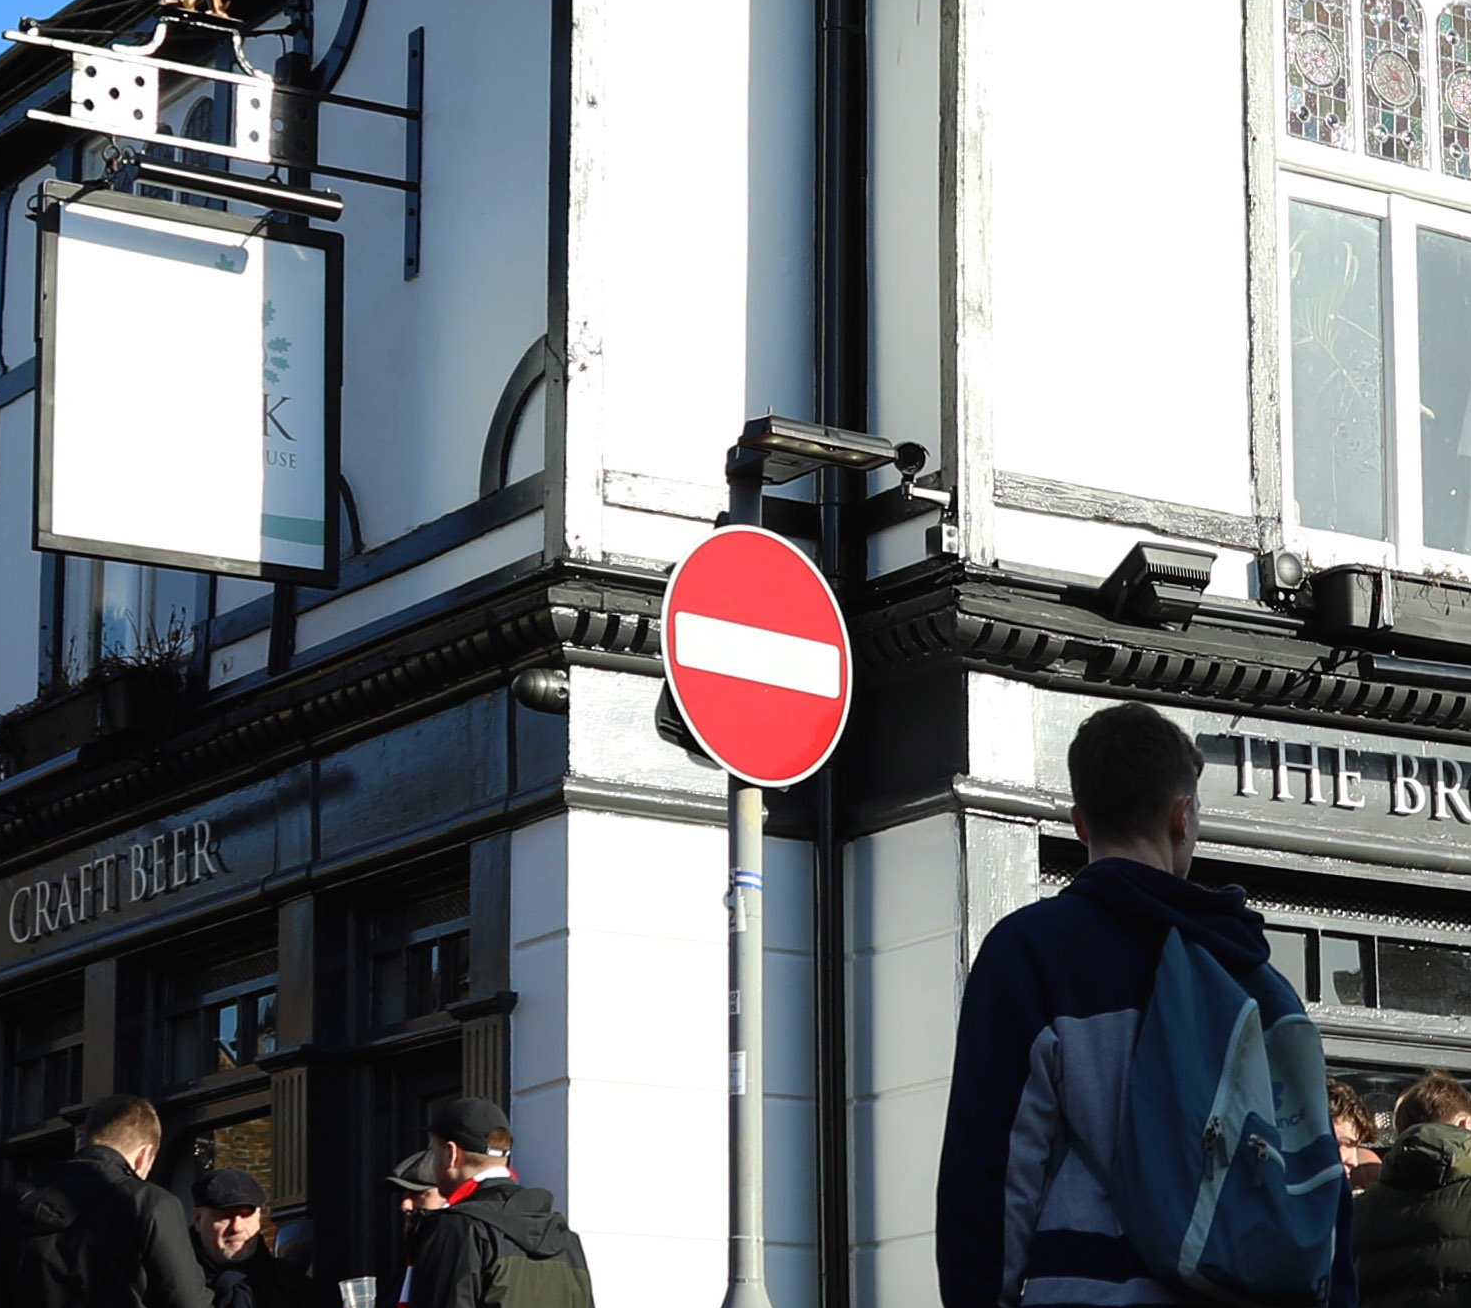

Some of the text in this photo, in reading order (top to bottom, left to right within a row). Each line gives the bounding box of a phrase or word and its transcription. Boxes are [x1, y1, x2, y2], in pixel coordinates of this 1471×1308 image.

[1229, 730, 1367, 808] THE
[9, 820, 218, 944] CRAFT BEER
